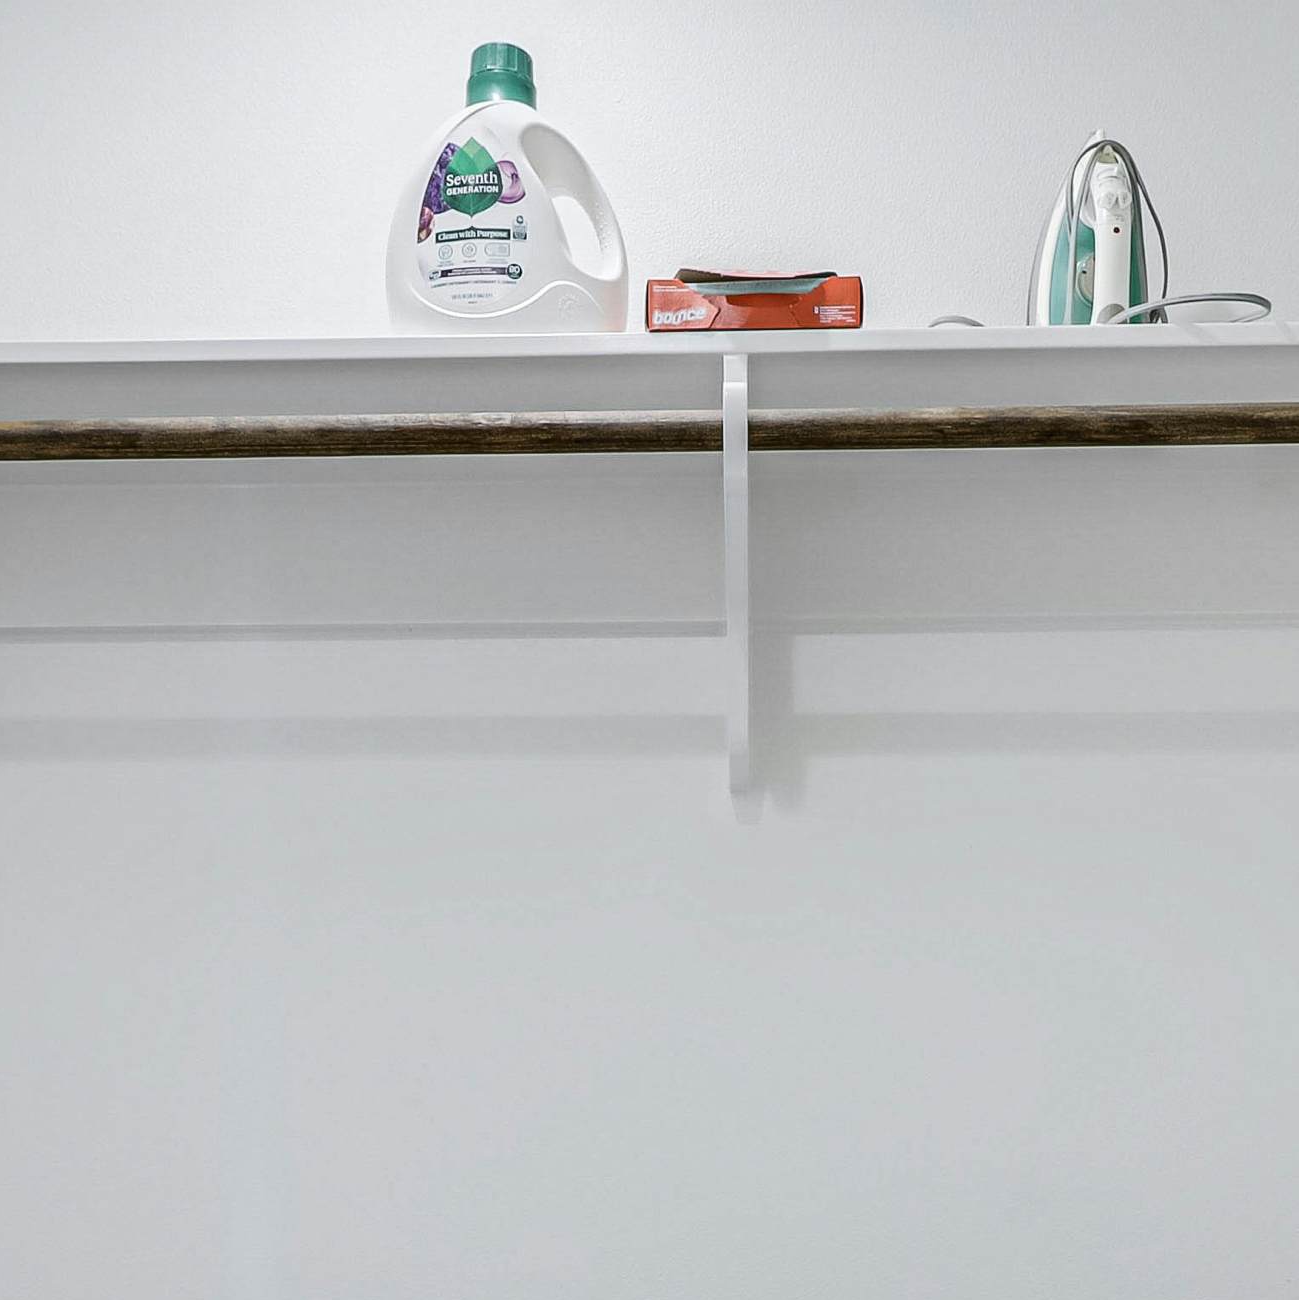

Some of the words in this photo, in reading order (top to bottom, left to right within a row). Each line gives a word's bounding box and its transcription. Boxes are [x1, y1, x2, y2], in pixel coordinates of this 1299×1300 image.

[446, 170, 498, 187] Seventh
[446, 185, 499, 196] GENERATION
[438, 232, 459, 241] Clean
[459, 230, 476, 239] with
[477, 230, 509, 239] Purpose
